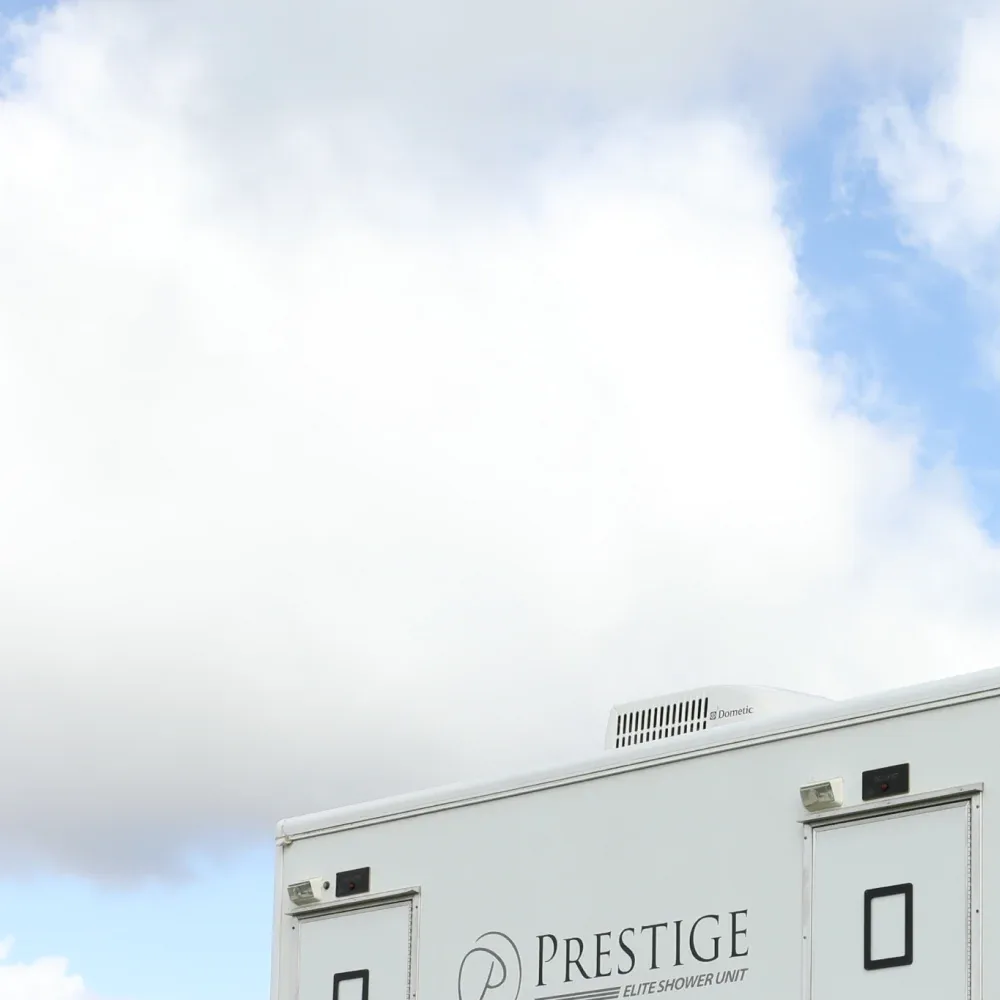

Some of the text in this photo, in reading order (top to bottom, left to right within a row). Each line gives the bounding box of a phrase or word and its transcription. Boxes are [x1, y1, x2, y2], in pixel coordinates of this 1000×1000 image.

[718, 705, 754, 719] Dometic
[535, 909, 749, 987] PRESTIGE
[623, 968, 749, 998] ELITE SHOWER UNIT
